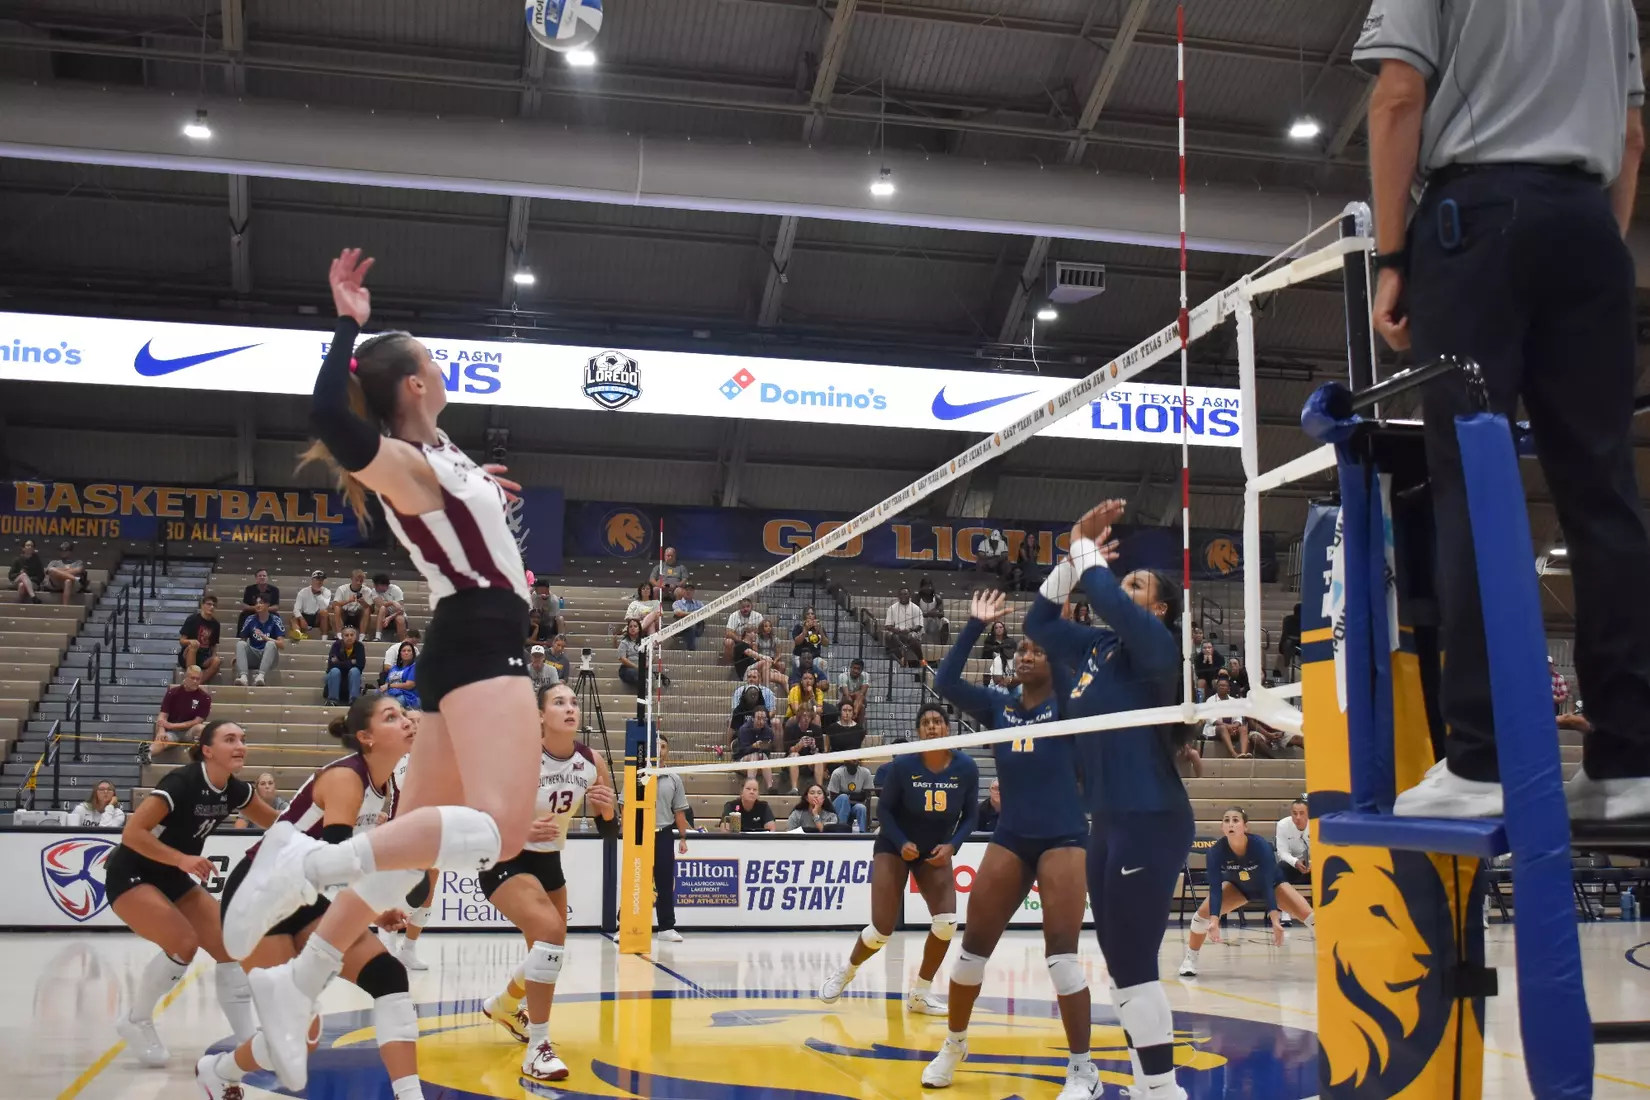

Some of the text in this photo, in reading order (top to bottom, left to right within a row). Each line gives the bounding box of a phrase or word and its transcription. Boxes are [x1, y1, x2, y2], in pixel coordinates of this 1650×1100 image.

[457, 351, 502, 363] A&M
[1140, 336, 1162, 359] TEXAS
[587, 370, 638, 386] LOREDO
[760, 383, 887, 410] Domino's
[1099, 391, 1239, 408] AST TEXAS A&M
[1089, 401, 1240, 437] LIONS
[14, 481, 343, 524] BASKETBALL
[0, 515, 120, 538] OURNAMENTS
[191, 521, 329, 546] ALL-AMERICANS
[763, 519, 863, 558] GO
[538, 773, 564, 787] OUTHERN
[549, 790, 573, 814] 13
[925, 789, 947, 811] 19
[677, 861, 735, 878] Hilton
[745, 860, 805, 883] BEST
[747, 886, 845, 910] TO STAY!
